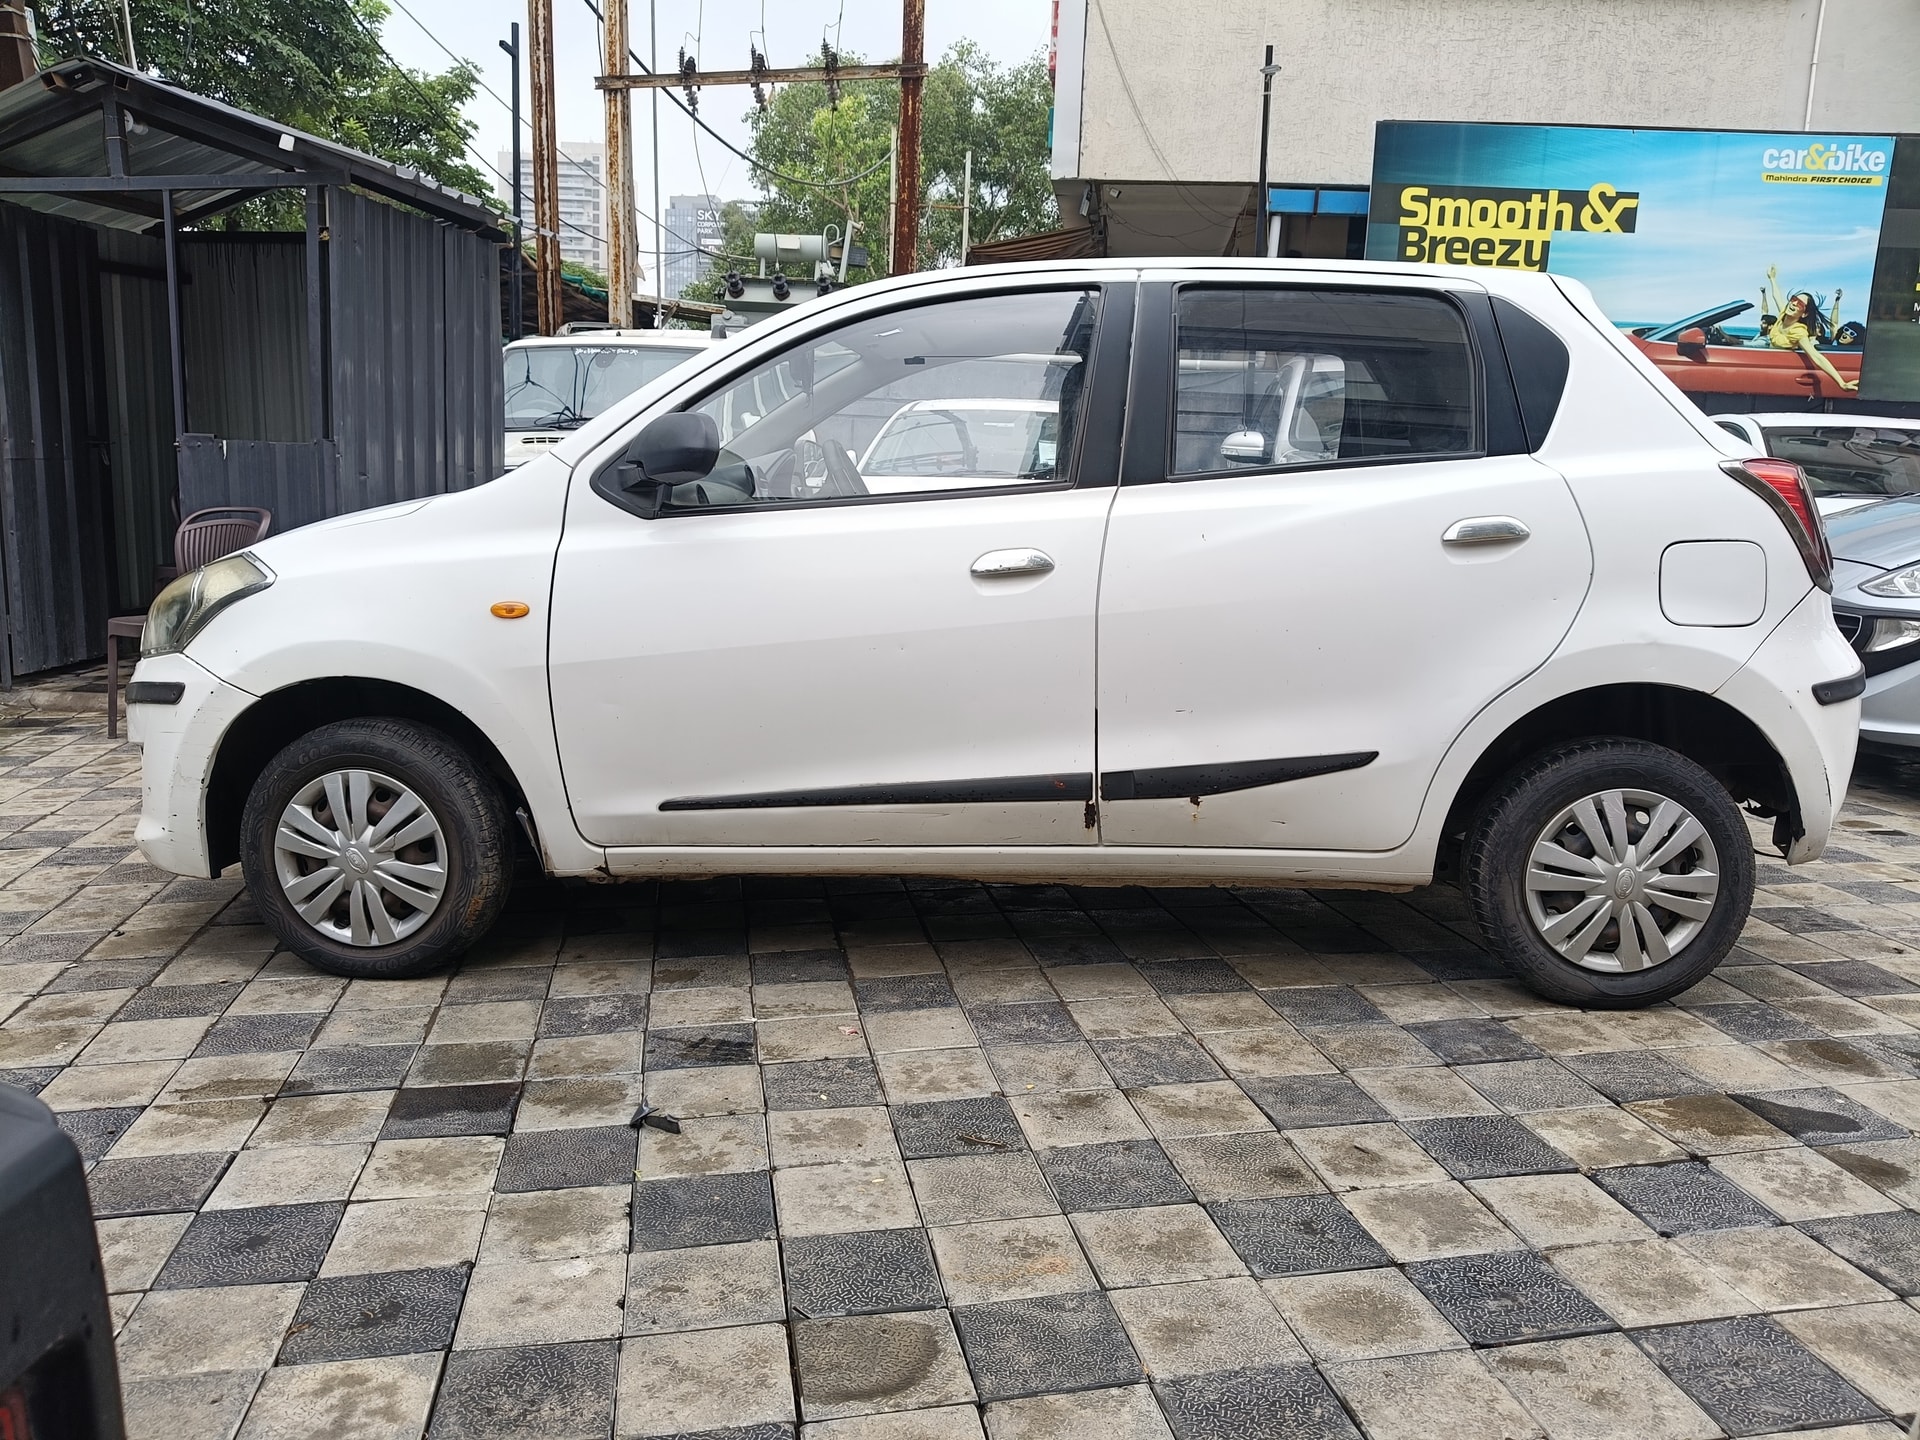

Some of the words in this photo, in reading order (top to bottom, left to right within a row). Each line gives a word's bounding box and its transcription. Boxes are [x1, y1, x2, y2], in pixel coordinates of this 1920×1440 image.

[1762, 143, 1886, 172] car&bike
[1765, 174, 1808, 183] Mahindra
[1810, 175, 1838, 183] FIRST
[1838, 176, 1873, 185] CHOICE
[697, 209, 721, 221] SKY
[1399, 186, 1574, 232] Smooth
[1580, 182, 1639, 233] &
[1397, 225, 1551, 272] Breezy
